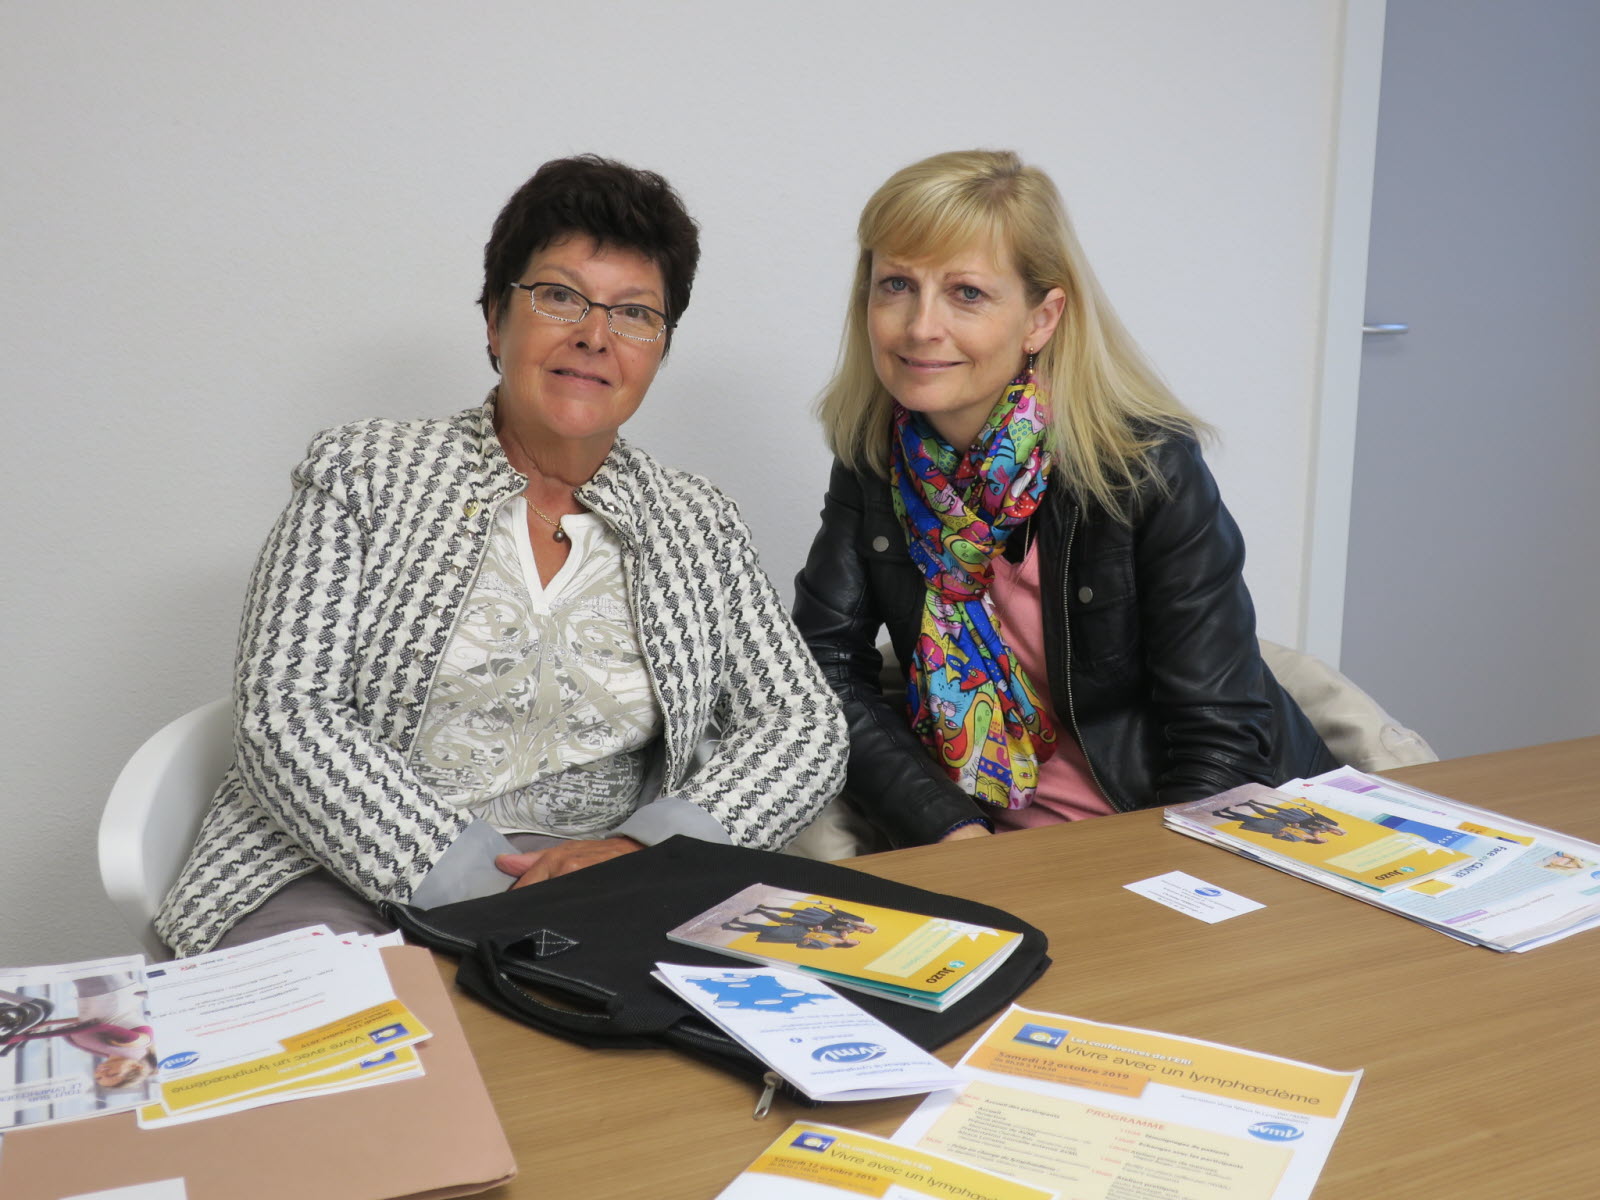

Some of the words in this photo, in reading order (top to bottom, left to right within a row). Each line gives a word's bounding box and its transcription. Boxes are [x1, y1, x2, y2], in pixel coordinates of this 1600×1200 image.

[925, 967, 957, 985] Juzo
[998, 1051, 1040, 1064] Samedi
[1043, 1059, 1055, 1067] 12
[1057, 1062, 1099, 1075] octobre
[1102, 1069, 1130, 1080] 2019
[1065, 1045, 1108, 1061] Vivre
[1113, 1057, 1157, 1072] avec
[1161, 1067, 1184, 1078] un
[1086, 1108, 1165, 1130] PROGRAMME
[830, 1149, 864, 1164] Vivre
[867, 1161, 903, 1175] avec
[905, 1171, 924, 1182] un
